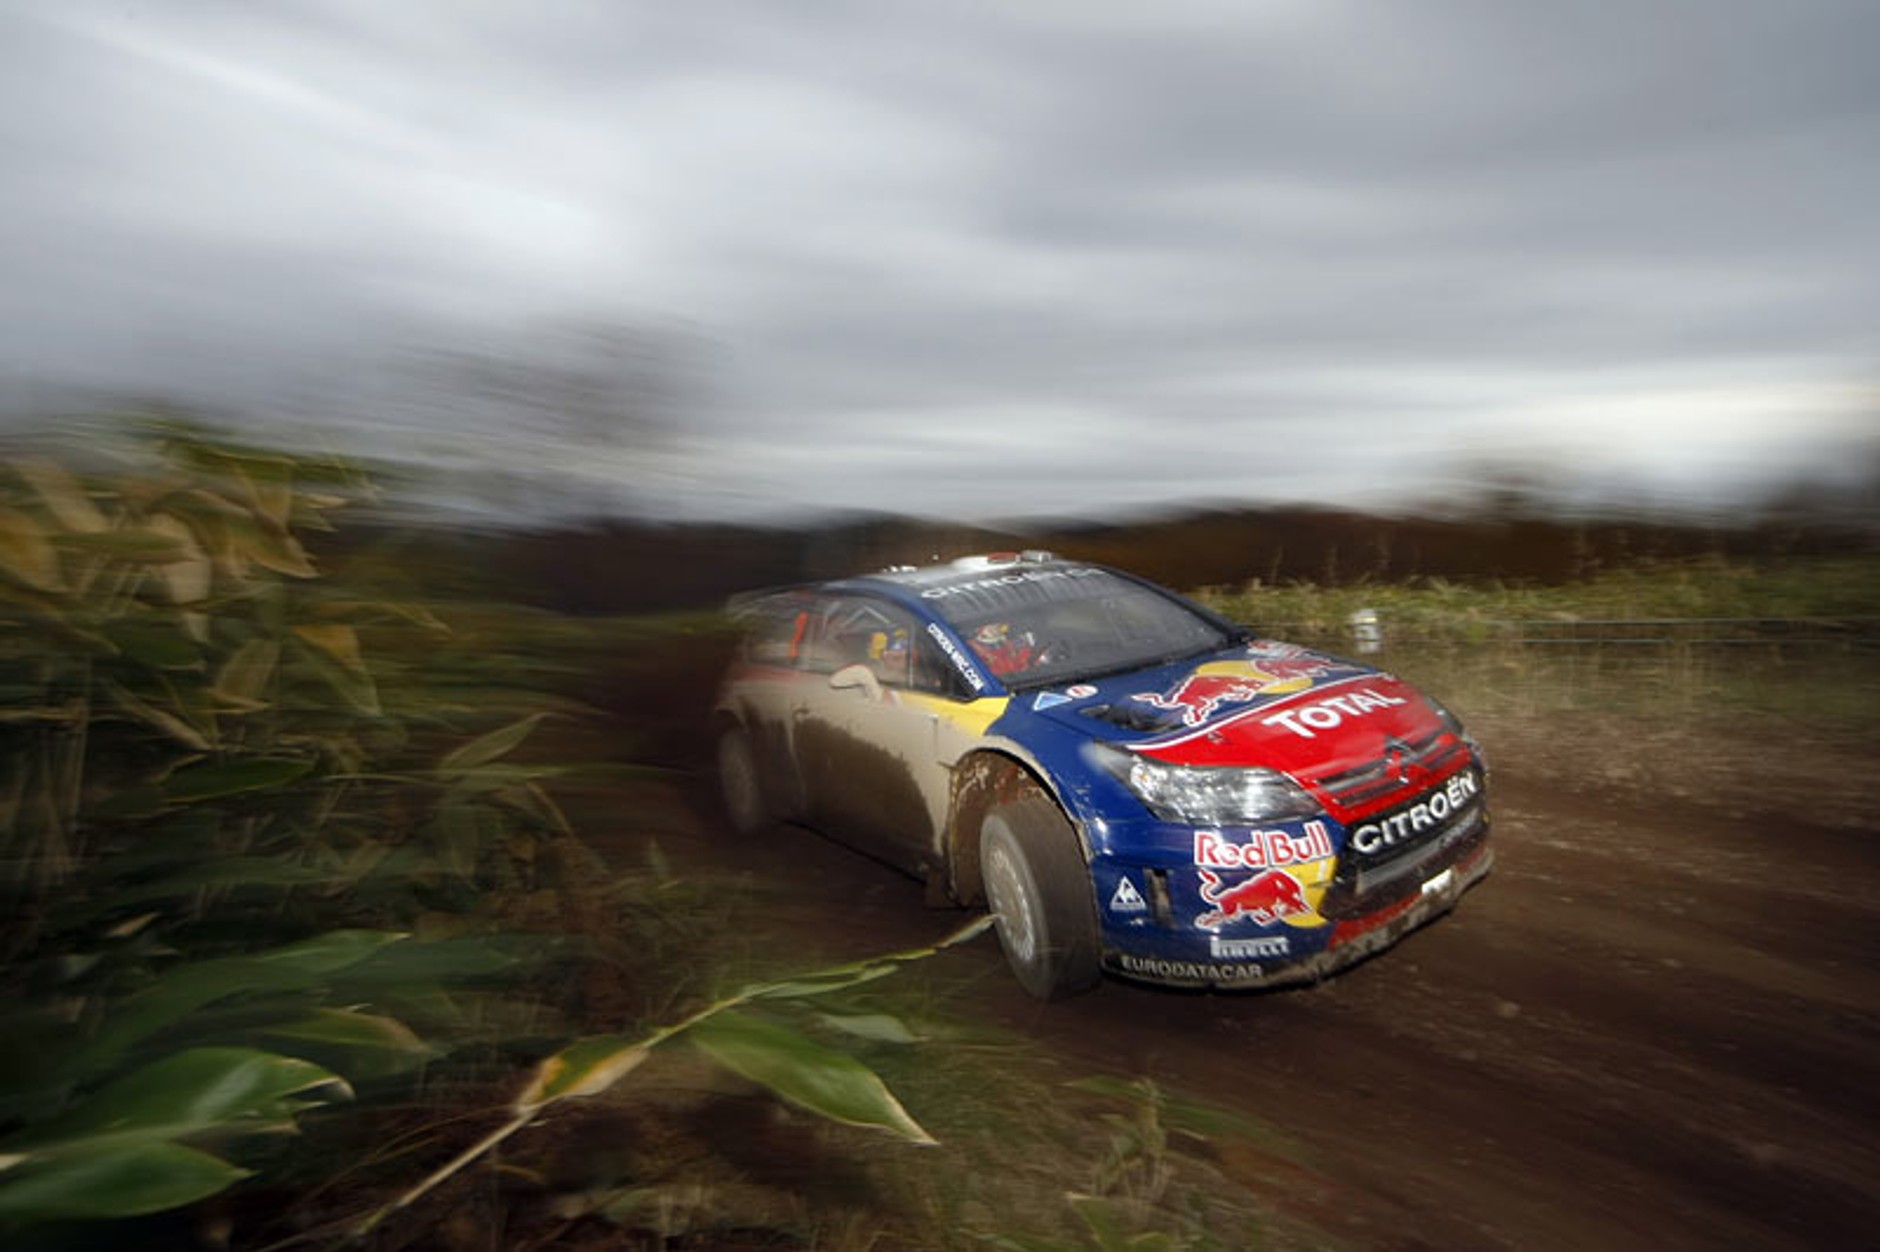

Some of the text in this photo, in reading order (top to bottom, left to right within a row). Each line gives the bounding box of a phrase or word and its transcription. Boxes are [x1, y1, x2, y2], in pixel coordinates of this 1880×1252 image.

[1261, 688, 1408, 738] TOTAL
[1353, 770, 1477, 854] CITROËN
[1195, 821, 1332, 866] Red Bull
[1120, 955, 1263, 979] EURODATACAR
